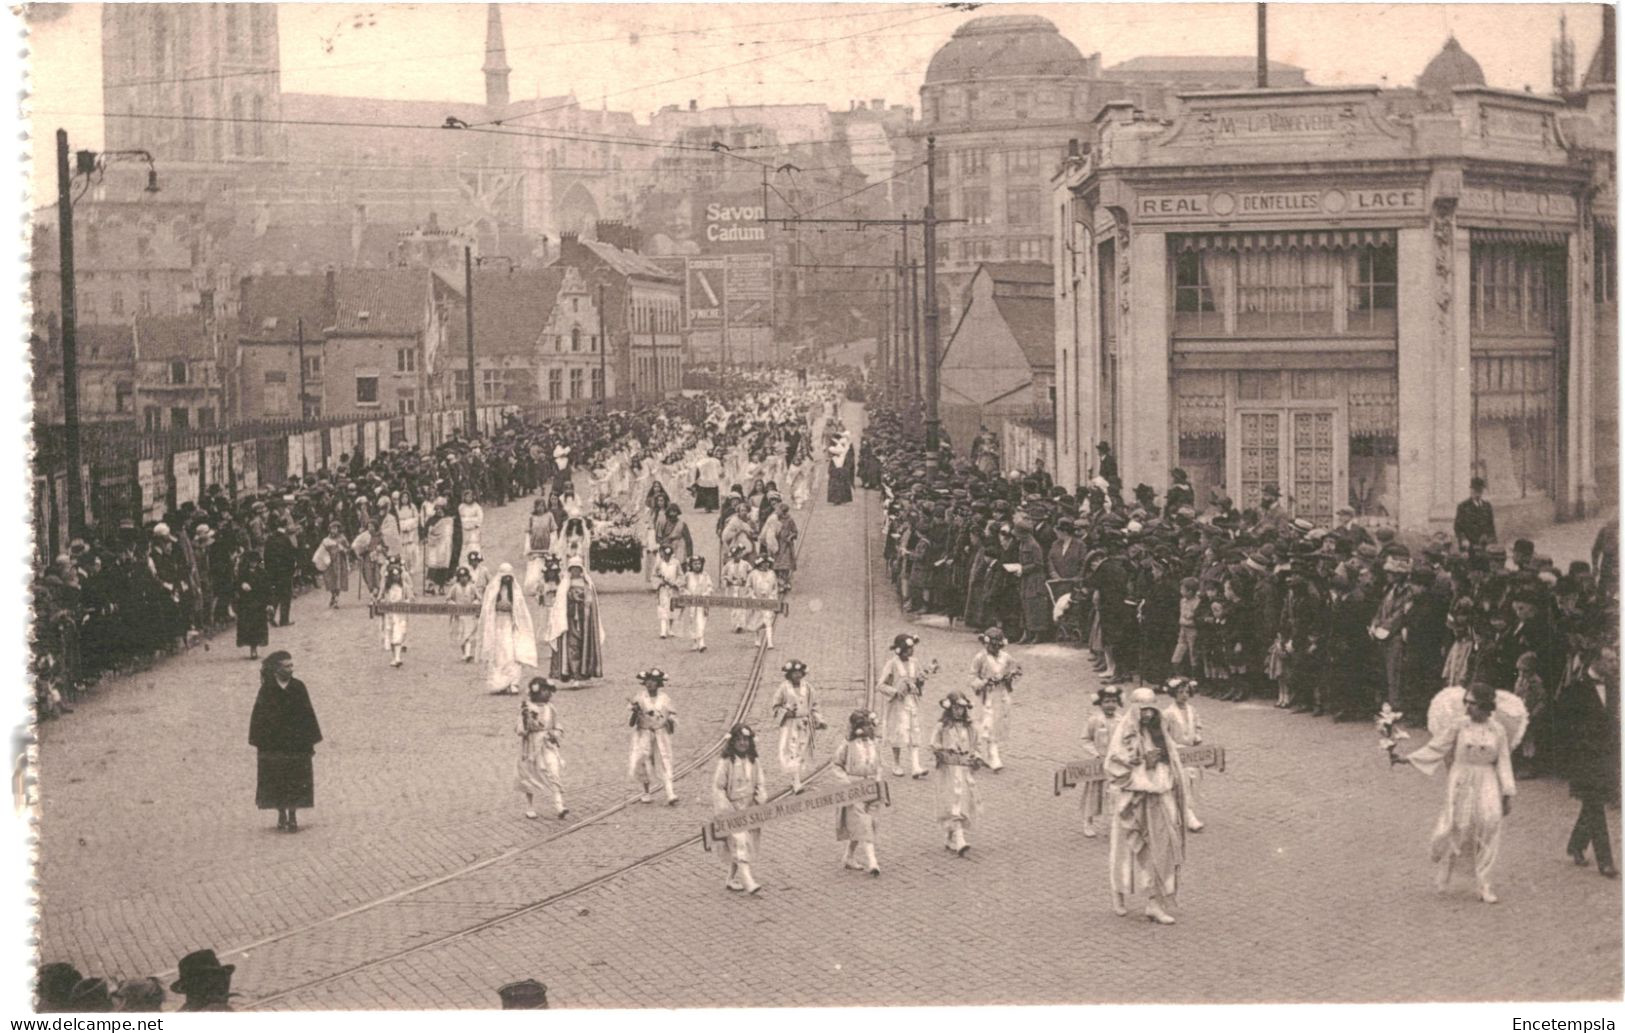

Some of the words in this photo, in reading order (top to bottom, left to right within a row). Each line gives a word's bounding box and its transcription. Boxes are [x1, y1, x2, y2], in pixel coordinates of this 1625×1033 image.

[706, 202, 765, 221] Savon
[1143, 198, 1202, 213] REAL
[1242, 194, 1318, 211] DENTELLES
[1358, 191, 1415, 208] LACE
[706, 223, 765, 241] Cadum
[1179, 750, 1213, 764] GNEUR
[716, 819, 727, 833] JE
[727, 815, 748, 830] VOUS
[749, 809, 773, 825] SALUE
[805, 794, 834, 810] PLEINE
[835, 790, 845, 802] DE
